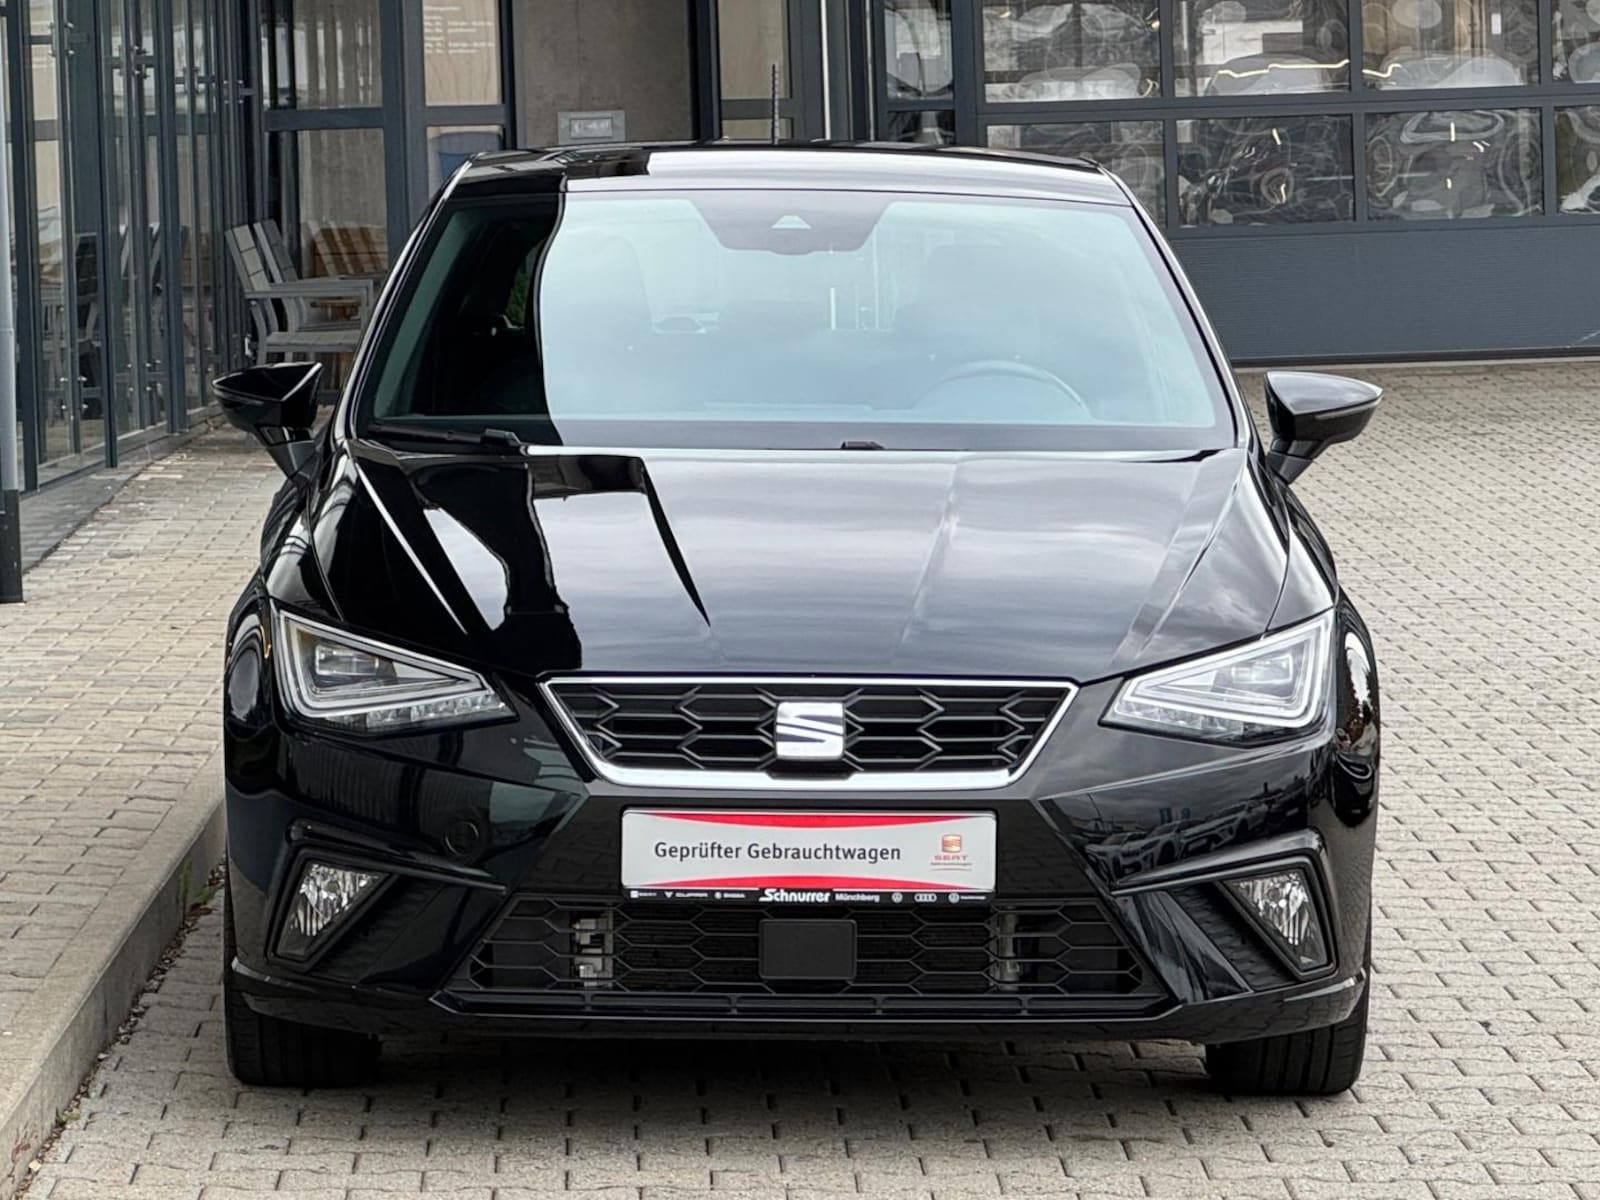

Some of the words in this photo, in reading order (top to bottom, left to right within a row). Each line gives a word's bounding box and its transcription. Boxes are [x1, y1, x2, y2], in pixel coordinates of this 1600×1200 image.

[654, 841, 742, 861] Geprüfter
[747, 843, 901, 864] Gebrauchtwagen
[759, 888, 831, 902] Schnurrer
[835, 893, 880, 902] Münchberg
